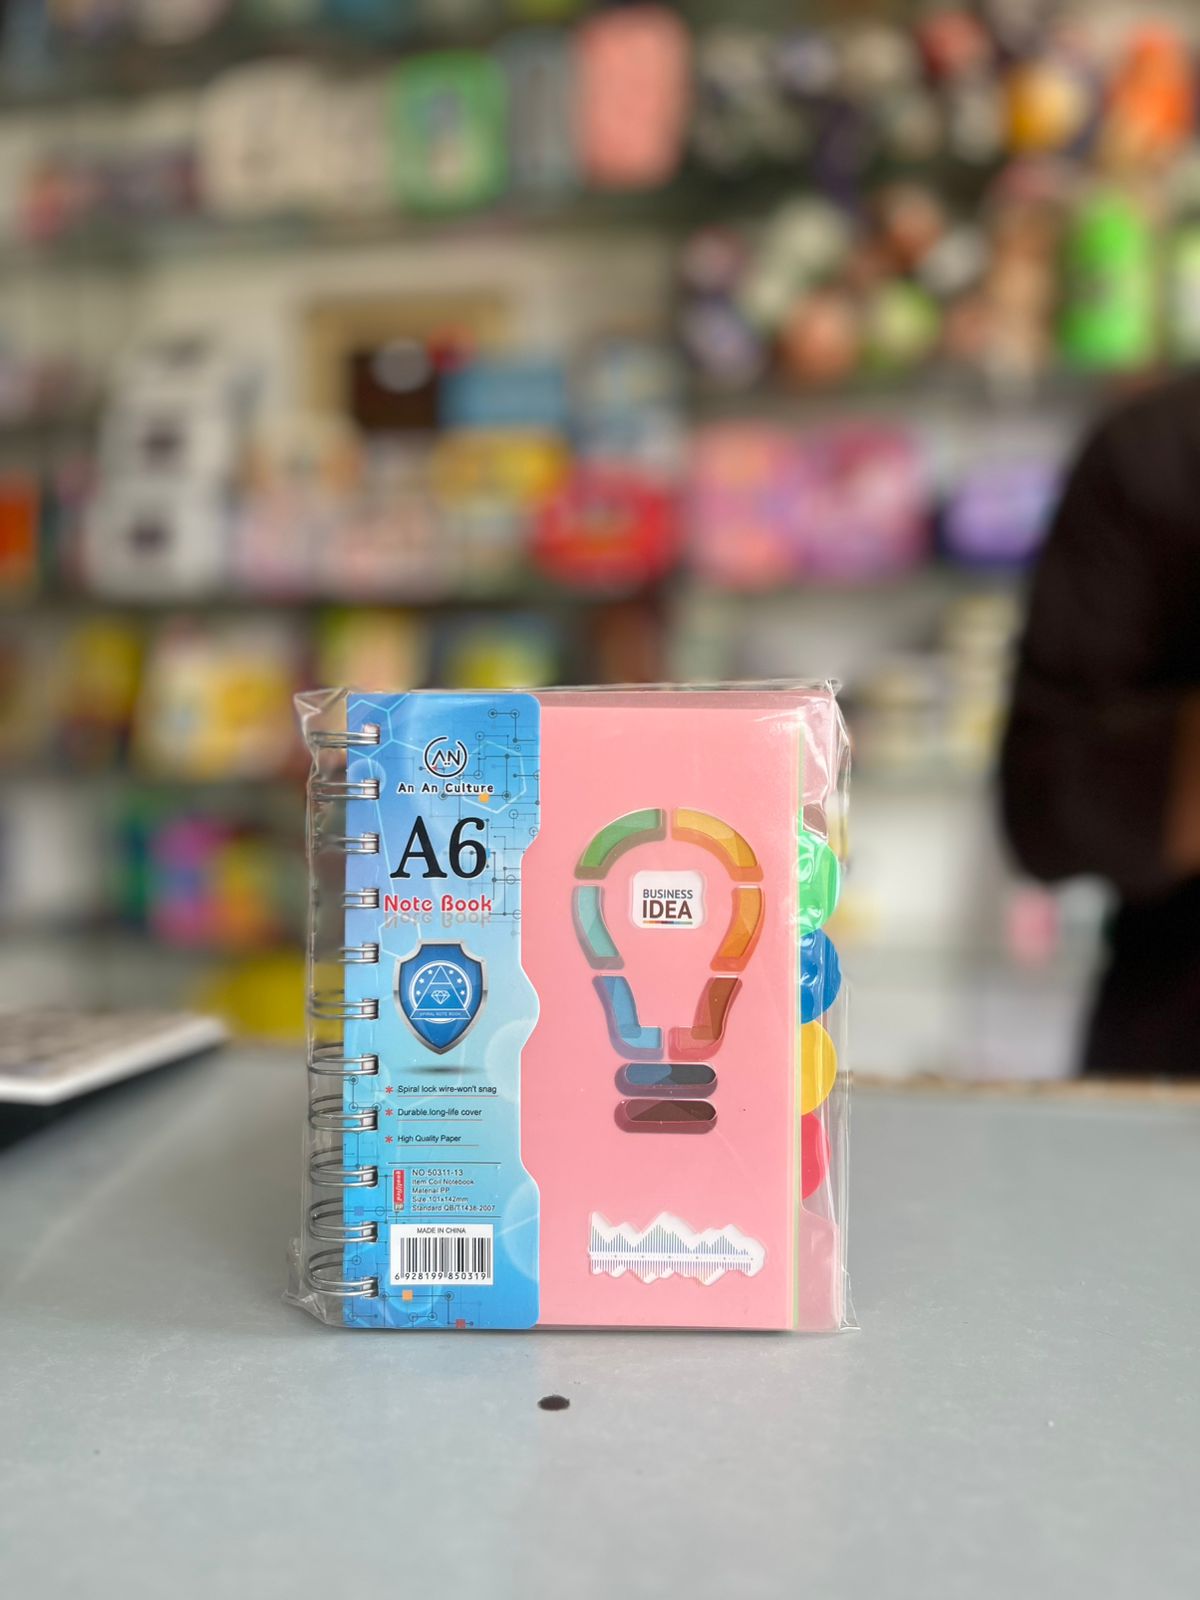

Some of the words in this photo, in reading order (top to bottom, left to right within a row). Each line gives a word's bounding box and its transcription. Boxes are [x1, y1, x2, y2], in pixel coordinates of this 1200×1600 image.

[398, 783, 415, 793] An
[422, 783, 438, 793] An
[445, 783, 494, 793] Culture
[390, 815, 487, 879] A6
[643, 888, 693, 899] BUSINESS
[384, 894, 433, 912] Note
[441, 894, 492, 912] Book
[642, 900, 693, 919] IDEA
[397, 1085, 420, 1094] Spiral
[421, 1085, 437, 1093] lock
[439, 1085, 477, 1093] wire-won't
[478, 1086, 497, 1094] snag
[397, 1135, 414, 1144] High
[415, 1135, 439, 1144] Quality
[440, 1135, 462, 1144] Paper
[412, 1204, 442, 1212] Standard
